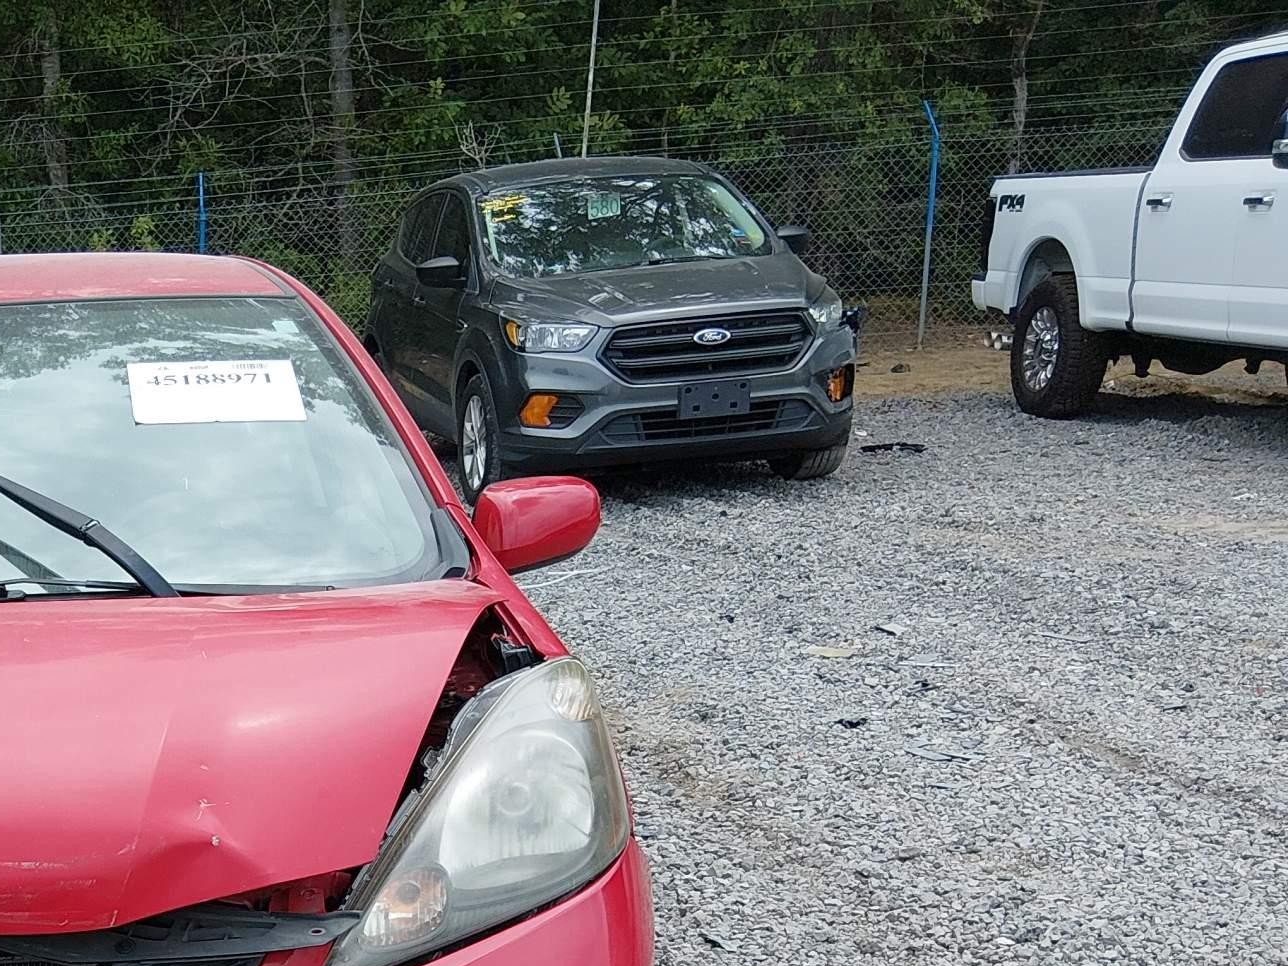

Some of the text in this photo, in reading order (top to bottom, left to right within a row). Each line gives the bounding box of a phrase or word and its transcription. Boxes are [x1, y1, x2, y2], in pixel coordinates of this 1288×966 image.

[590, 198, 619, 218] 580
[998, 194, 1025, 213] FX4
[146, 372, 272, 386] 45188971
